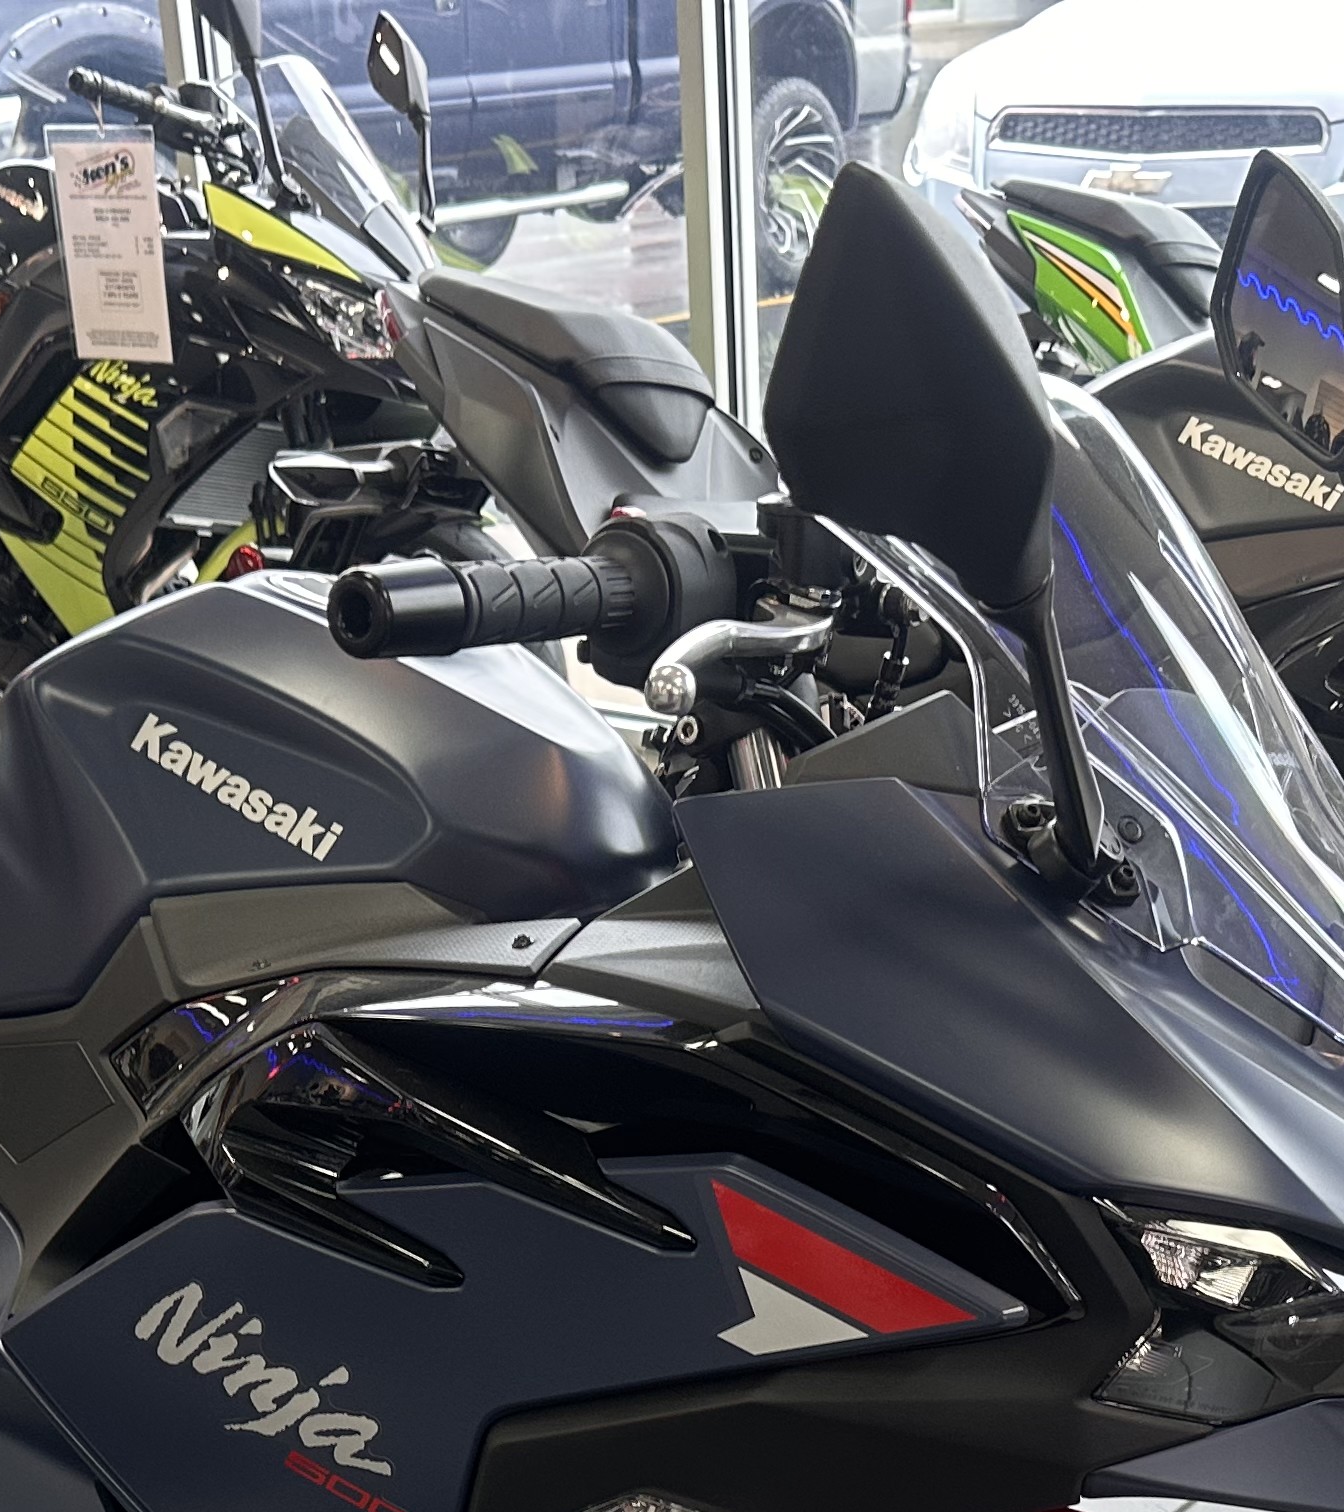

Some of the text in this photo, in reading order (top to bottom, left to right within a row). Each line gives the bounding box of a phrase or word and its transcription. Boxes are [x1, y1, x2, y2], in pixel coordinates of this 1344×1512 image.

[90, 360, 158, 408] Ninja
[129, 713, 345, 862] Kawasaki
[134, 1282, 392, 1477] Ninja
